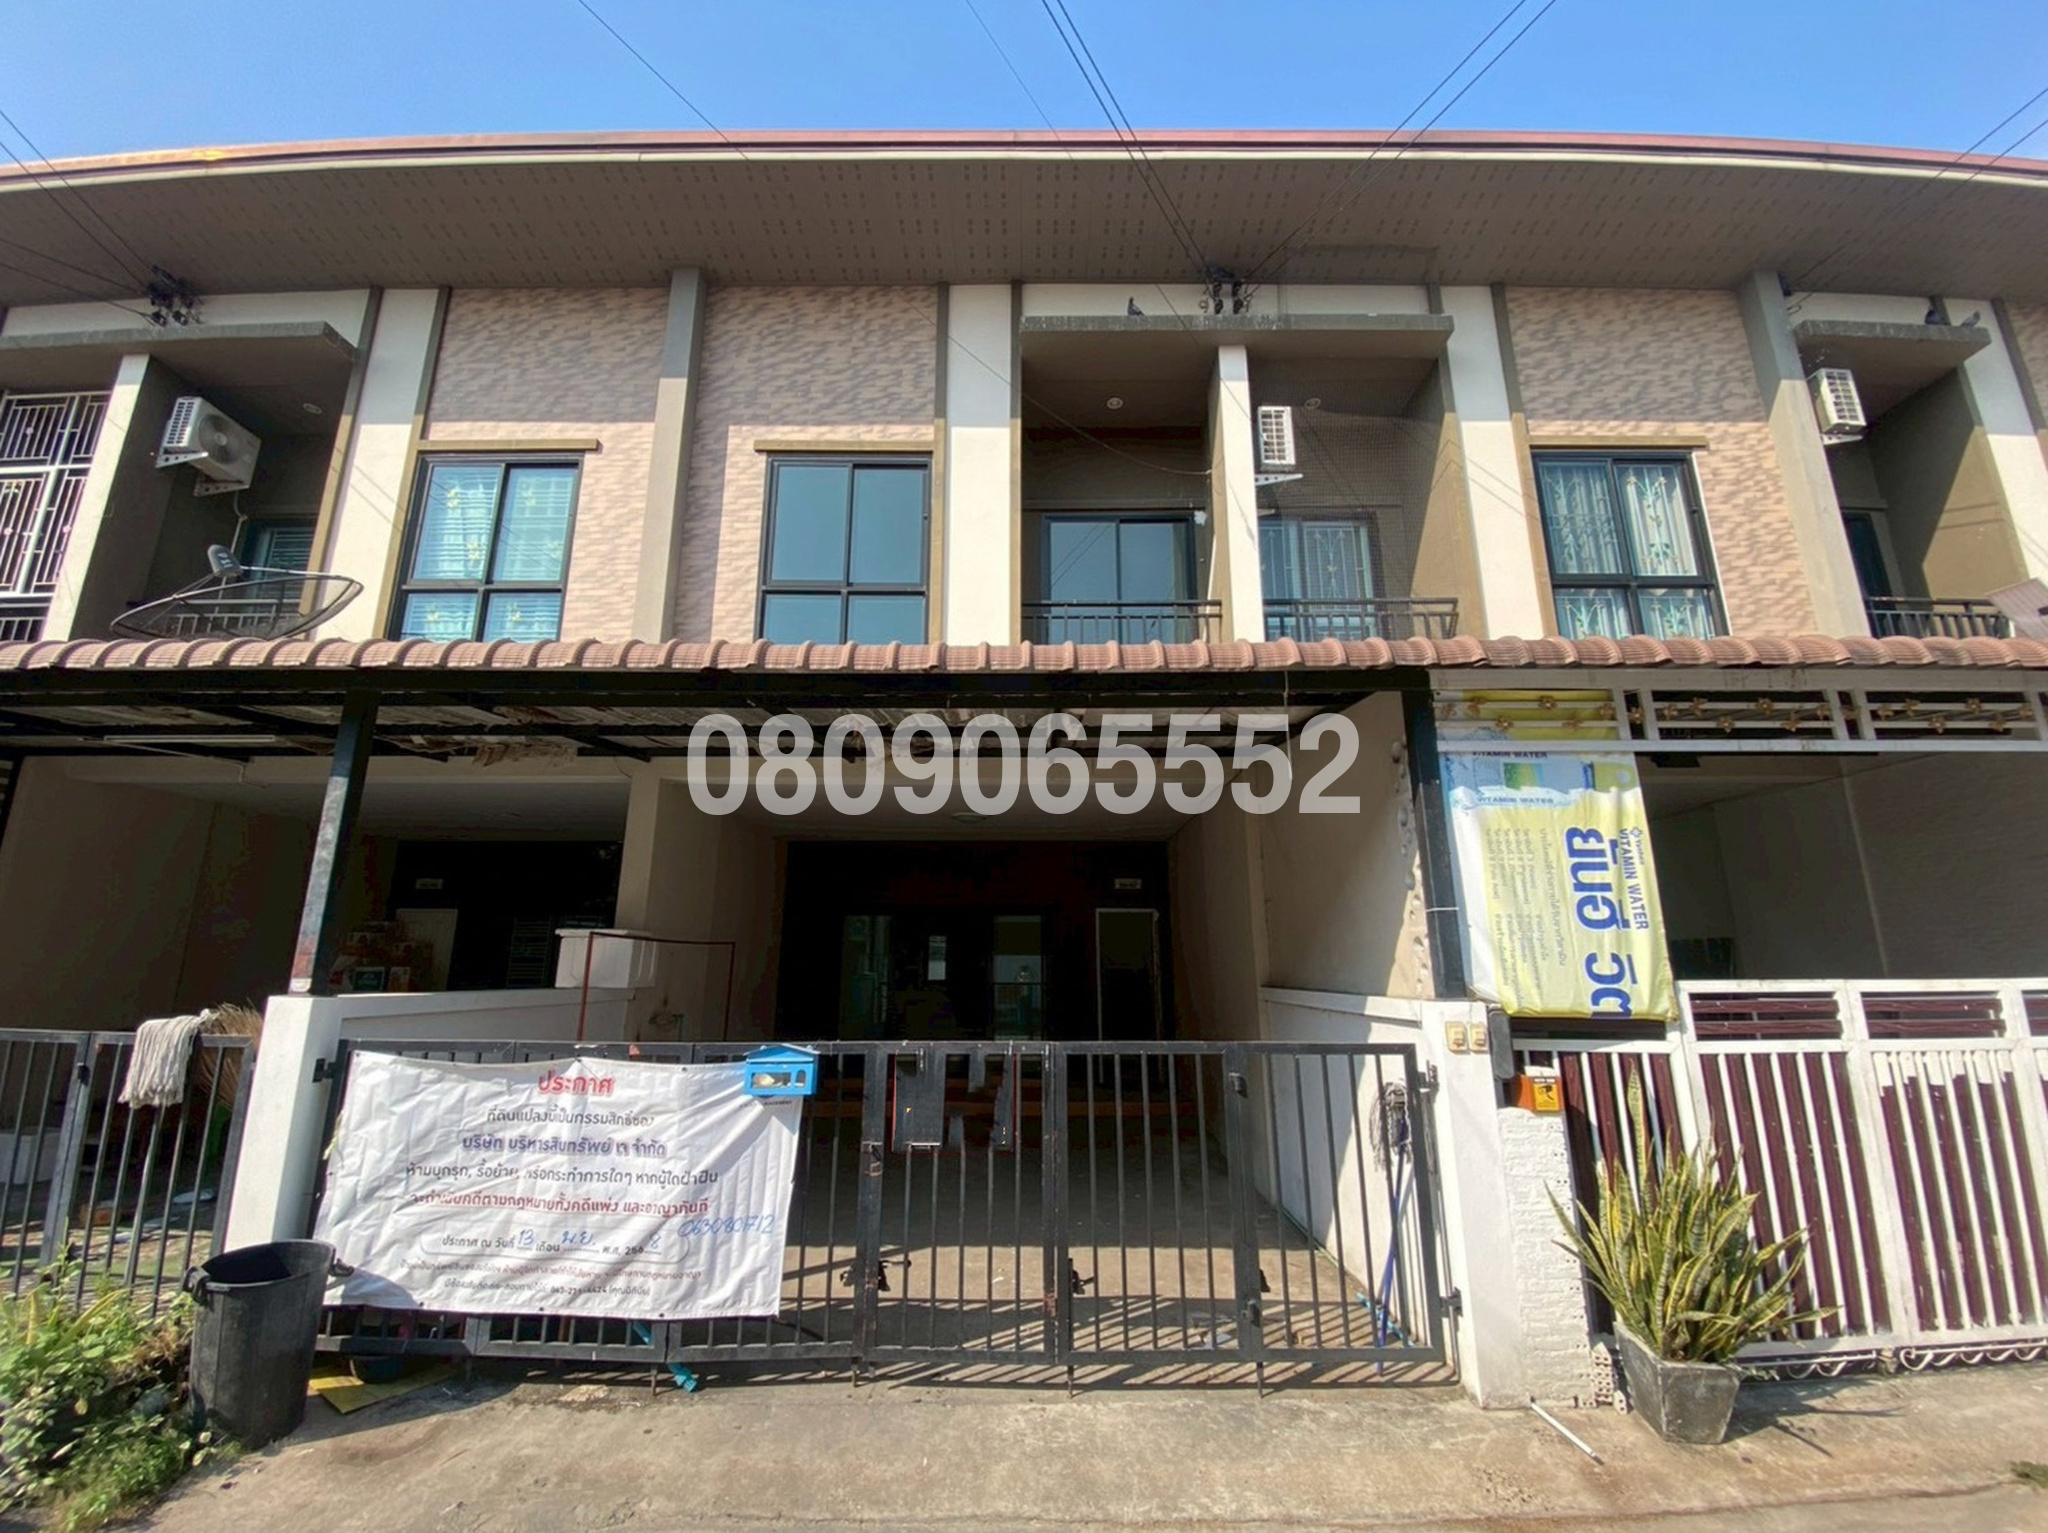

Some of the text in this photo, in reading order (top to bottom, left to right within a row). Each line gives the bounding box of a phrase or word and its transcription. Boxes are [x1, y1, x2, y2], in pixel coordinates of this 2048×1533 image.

[1513, 751, 1548, 759] WATER
[1477, 796, 1554, 805] VITAMIN WATER
[1565, 826, 1631, 931] ยันฮี
[1619, 828, 1649, 930] VITAMIN WATER
[537, 1069, 615, 1096] ประกาศ
[462, 1133, 503, 1150] บริษัท
[508, 1134, 612, 1153] บริหารสินทรัพย์
[631, 1137, 667, 1157] จำกัด
[441, 1234, 478, 1247] ประกาศ
